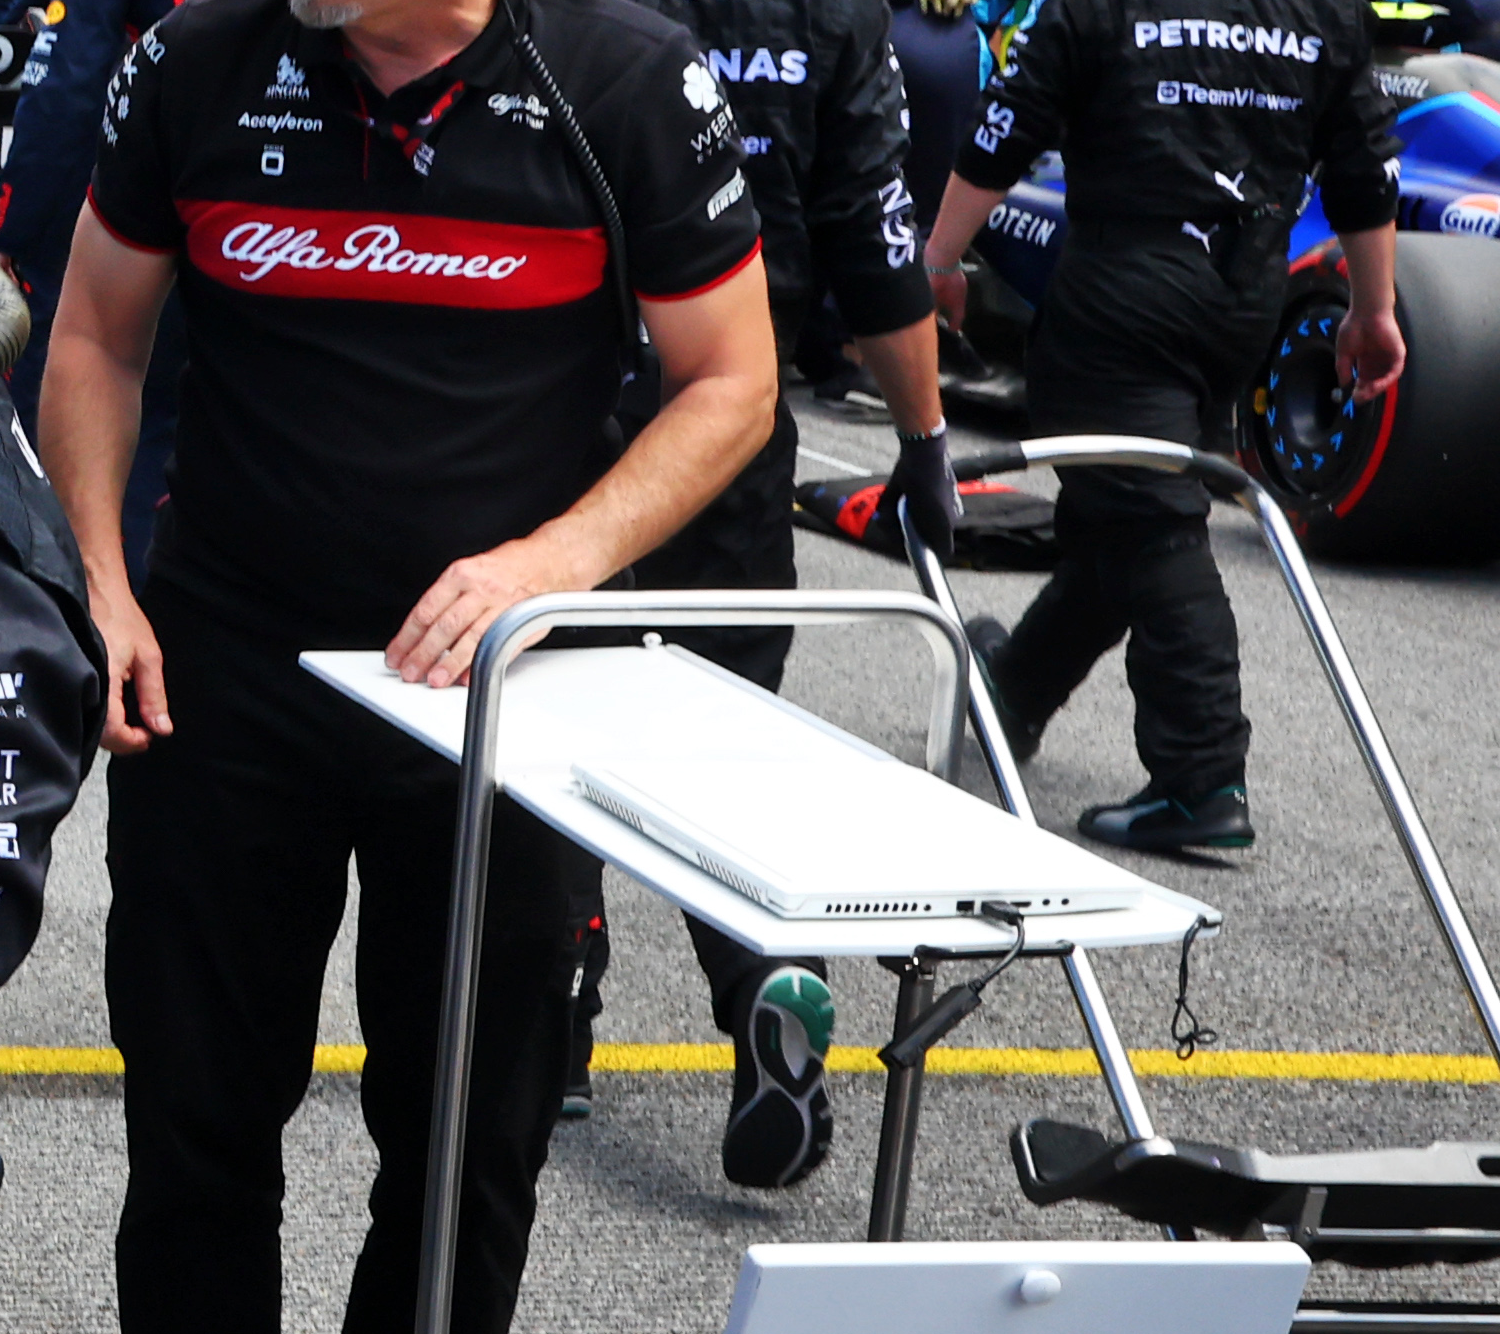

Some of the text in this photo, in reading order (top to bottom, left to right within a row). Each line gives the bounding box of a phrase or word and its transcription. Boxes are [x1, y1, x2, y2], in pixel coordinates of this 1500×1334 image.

[1134, 19, 1323, 63] PETRONAS
[1182, 81, 1303, 112] TeamViewer
[988, 203, 1056, 248] OTEIN
[222, 222, 528, 282] Alfa Romeo
